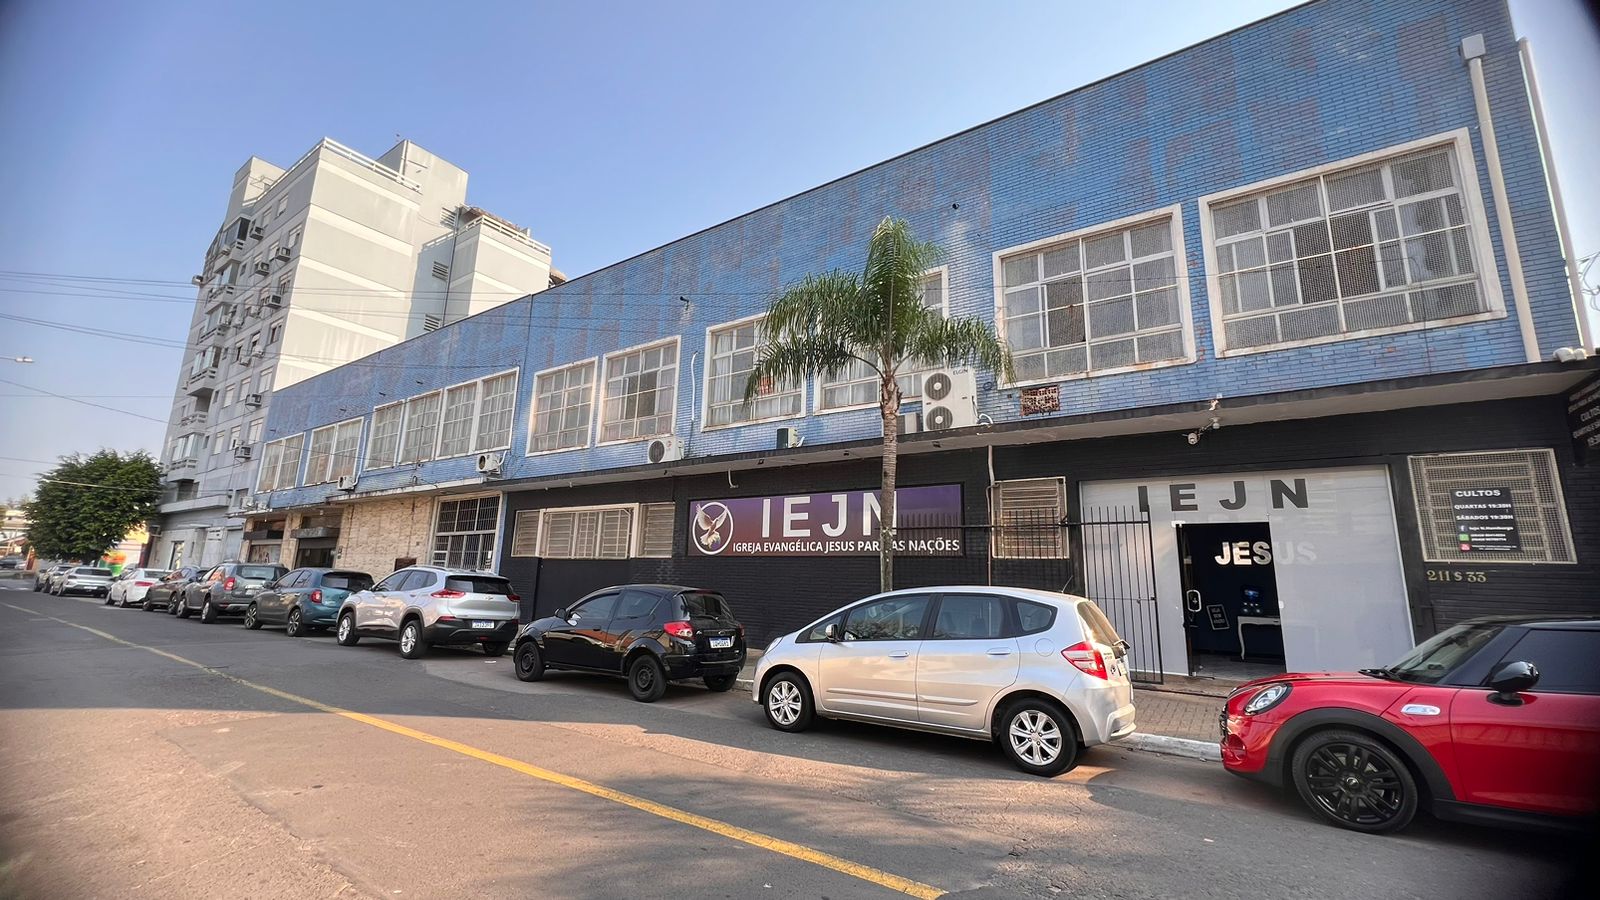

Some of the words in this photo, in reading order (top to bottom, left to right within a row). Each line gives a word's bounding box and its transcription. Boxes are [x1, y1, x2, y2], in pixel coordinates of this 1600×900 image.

[1138, 479, 1308, 512] IEJN
[1455, 489, 1501, 497] CULTOS
[733, 542, 762, 554] IGREJA
[763, 539, 823, 552] EVANGÉLICA
[824, 540, 855, 554] JESUS
[857, 540, 881, 552] PAR
[892, 540, 905, 551] AS
[908, 537, 960, 554] NAÇÕES
[1214, 541, 1317, 565] JESUS
[1466, 571, 1487, 583] 33
